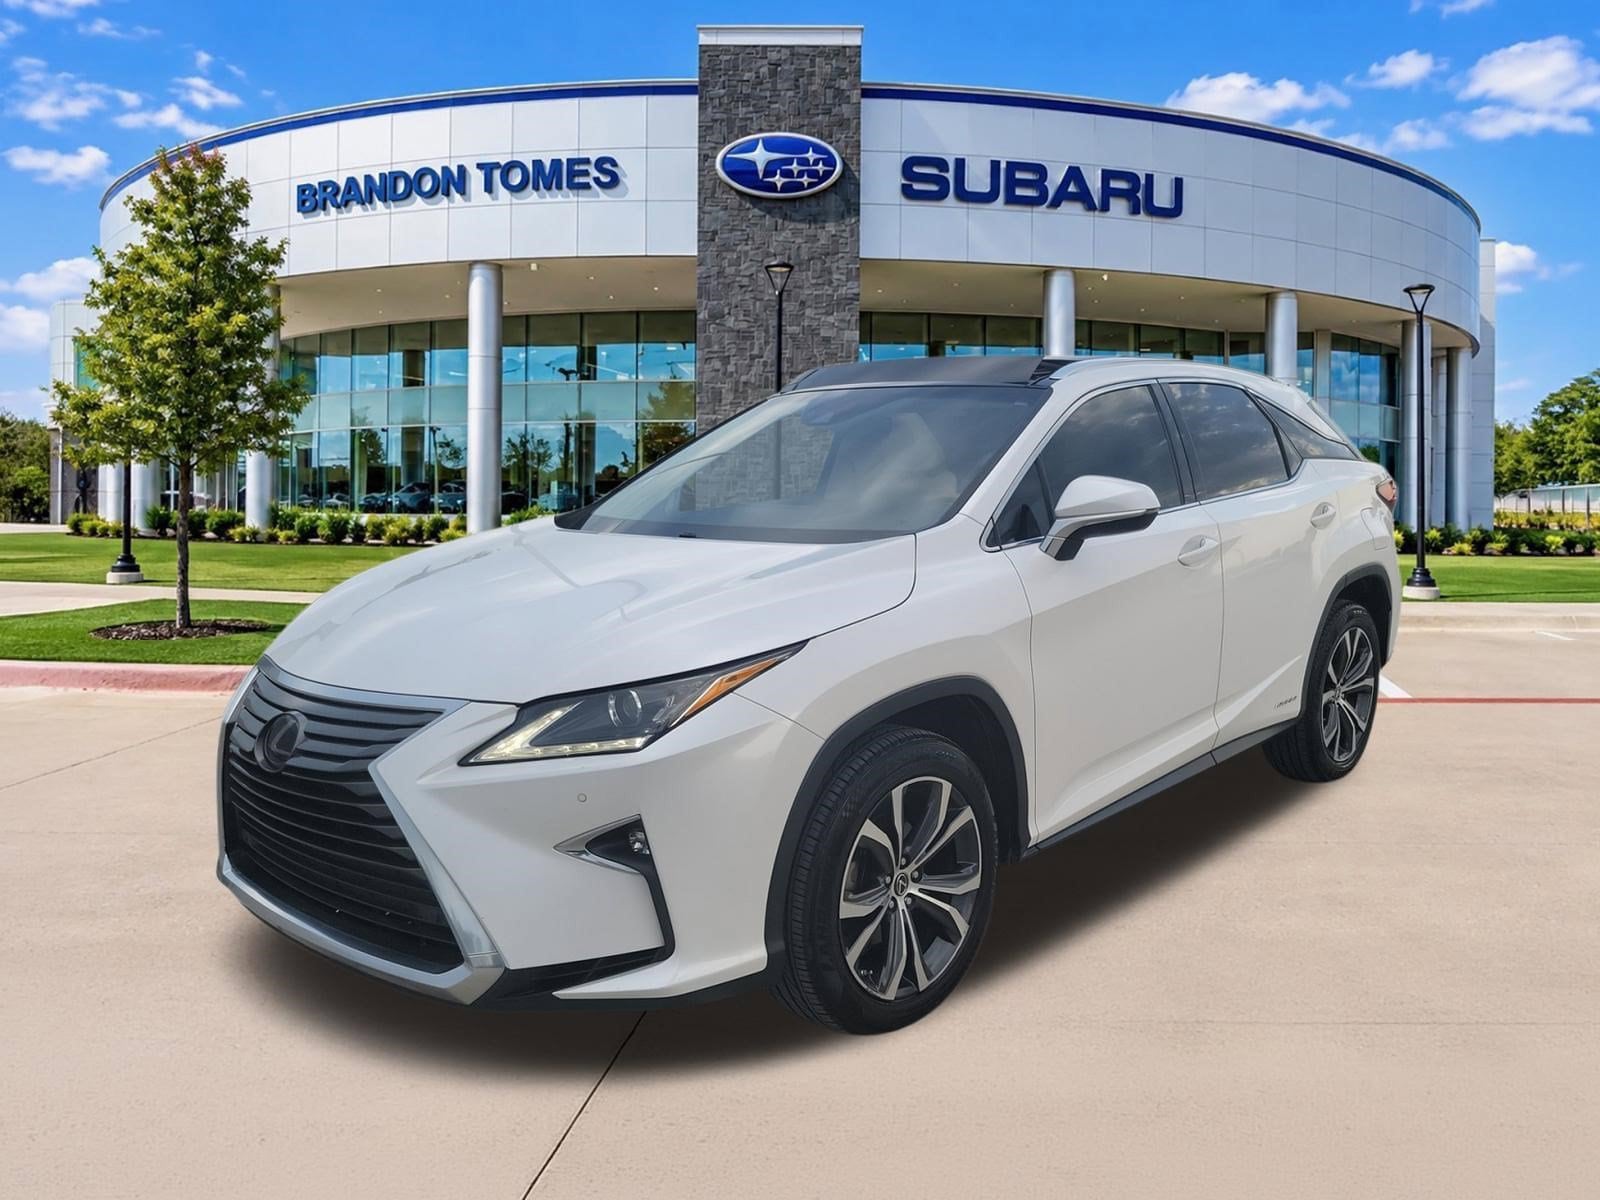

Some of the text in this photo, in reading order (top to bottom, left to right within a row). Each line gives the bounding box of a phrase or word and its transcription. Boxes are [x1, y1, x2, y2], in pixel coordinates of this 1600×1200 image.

[297, 156, 620, 213] BRANDON TOMES
[901, 155, 1184, 218] SUBARU
